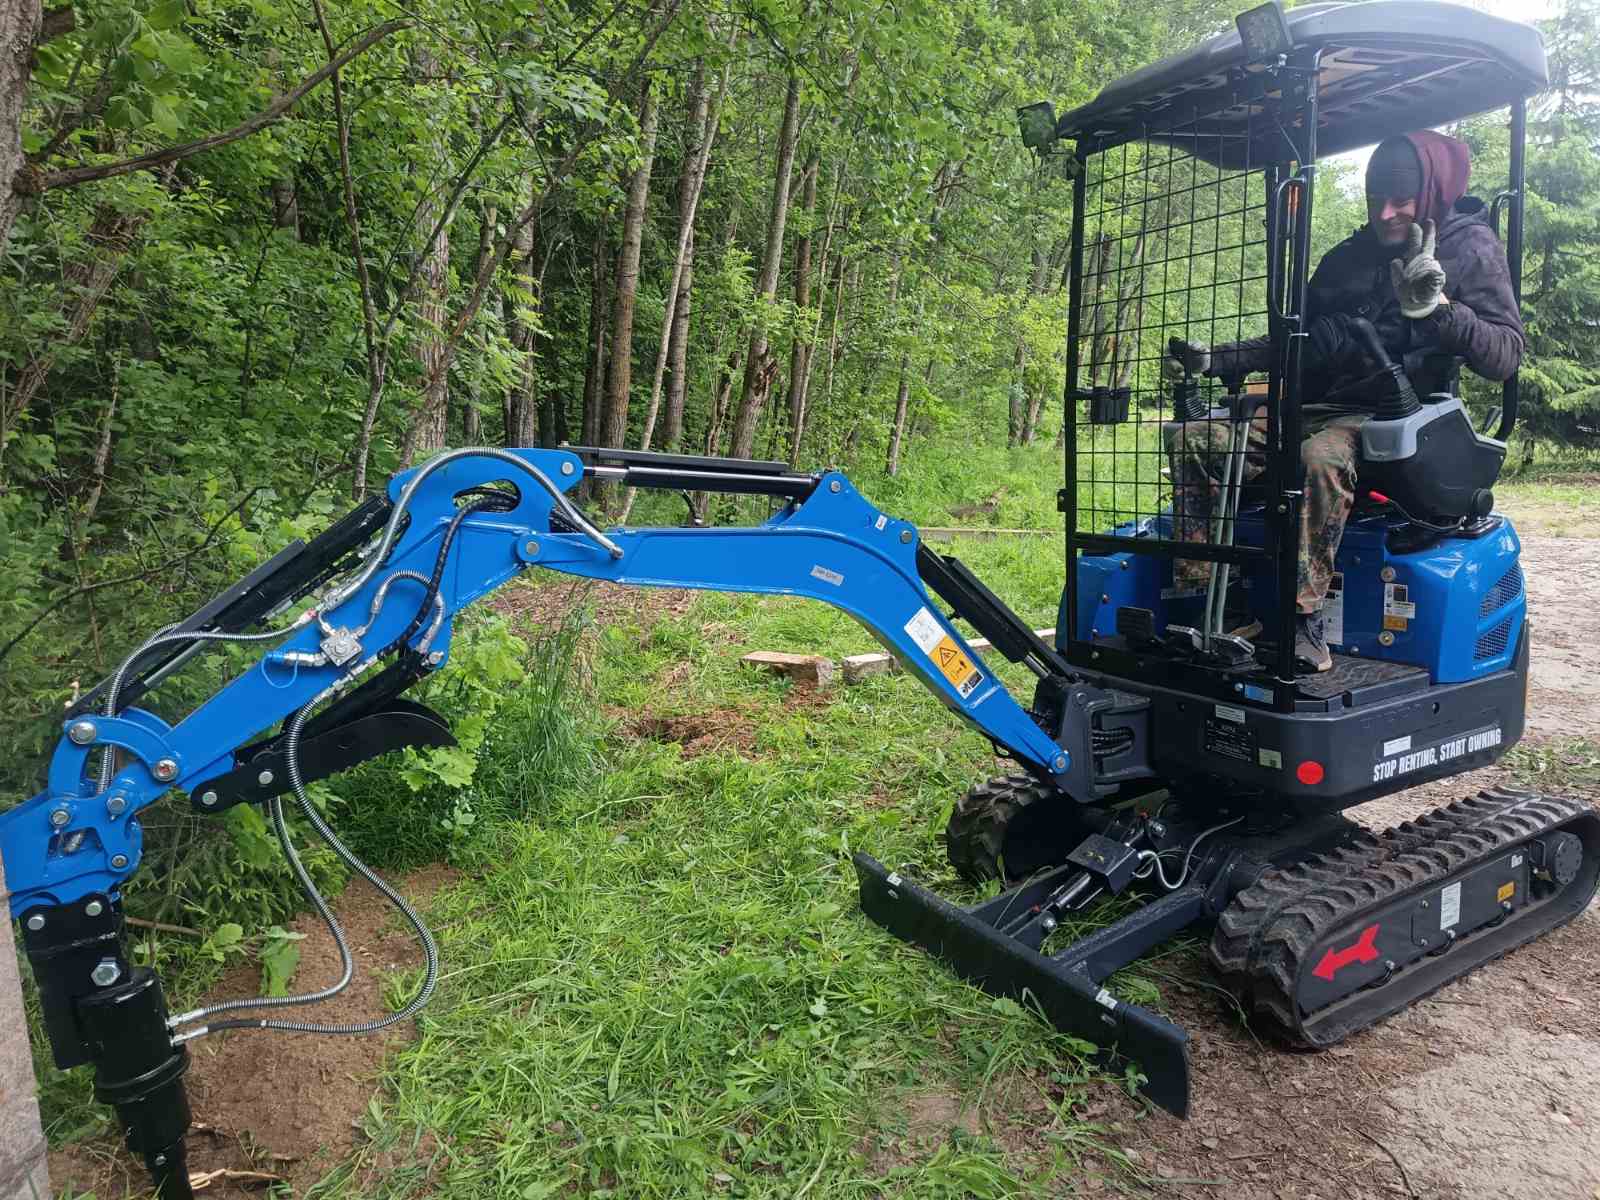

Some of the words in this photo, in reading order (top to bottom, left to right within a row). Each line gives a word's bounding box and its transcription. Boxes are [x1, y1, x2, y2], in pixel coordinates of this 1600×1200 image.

[1373, 760, 1397, 782] STOP
[1398, 748, 1438, 774] RENTING,
[1439, 738, 1467, 762] START
[1467, 728, 1502, 752] OWNING
